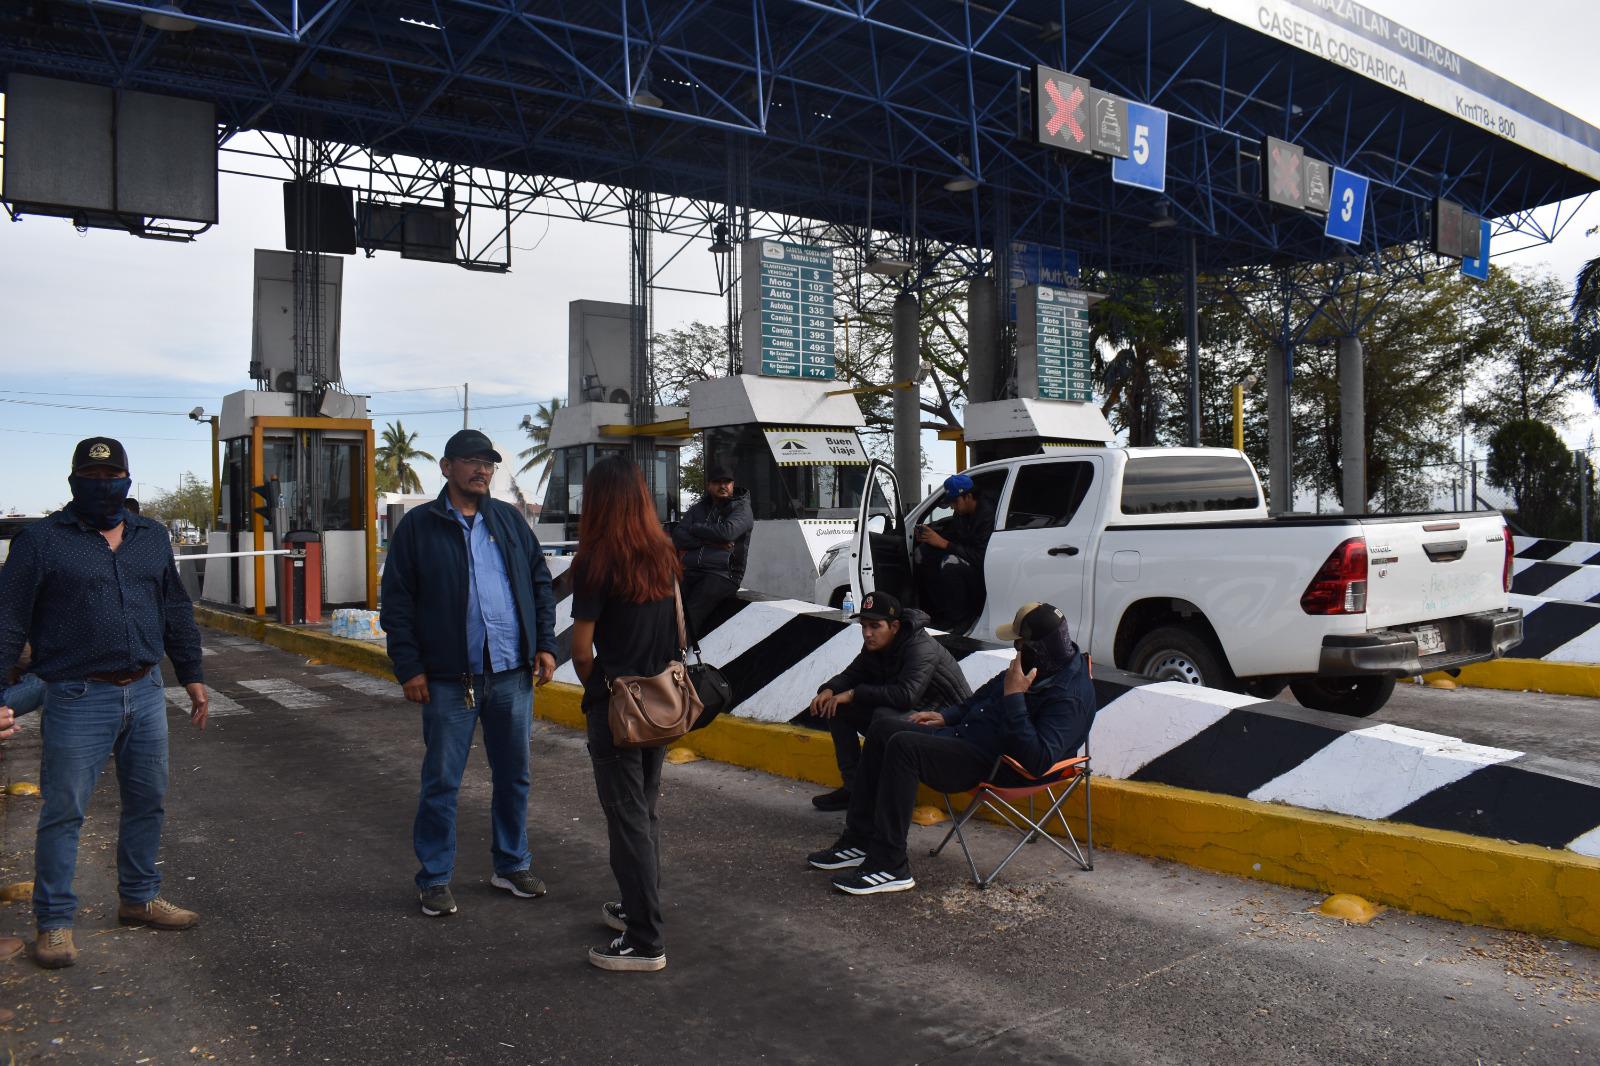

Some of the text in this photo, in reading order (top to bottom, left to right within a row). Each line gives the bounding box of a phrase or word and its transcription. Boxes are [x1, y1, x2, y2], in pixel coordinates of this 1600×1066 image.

[1257, 6, 1408, 90] CASETA COSTARICA
[1498, 115, 1516, 139] 800
[1133, 124, 1150, 166] 5
[1341, 188, 1355, 223] 3
[813, 270, 820, 281] $
[769, 277, 824, 292] Moto 102
[769, 288, 825, 304] Auto 205
[808, 306, 825, 315] 335
[809, 319, 825, 328] 348
[1042, 316, 1082, 328] Moto 102
[1043, 326, 1060, 334] Auto
[809, 331, 826, 340] 395
[809, 343, 826, 352] 495
[809, 355, 826, 364] 102
[809, 368, 826, 376] 174
[825, 437, 852, 446] Buen
[829, 446, 856, 456] Viaje
